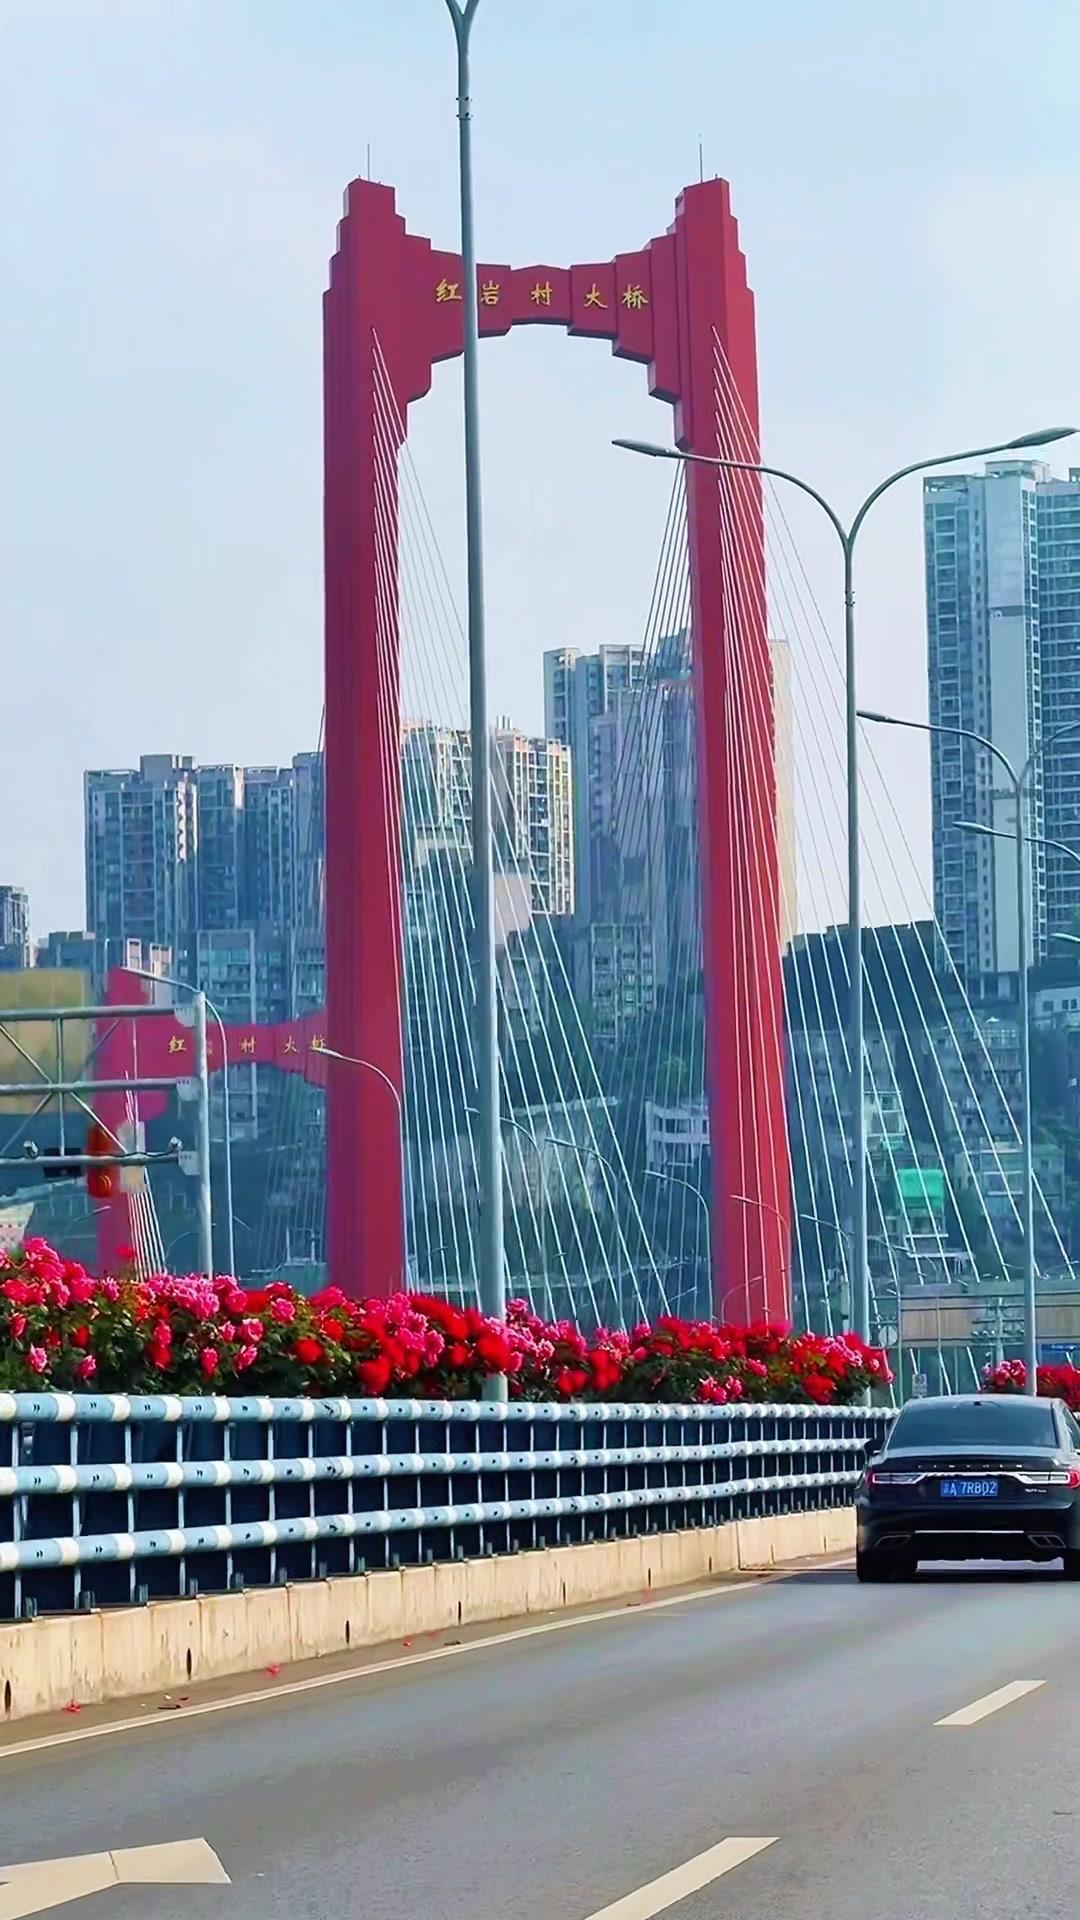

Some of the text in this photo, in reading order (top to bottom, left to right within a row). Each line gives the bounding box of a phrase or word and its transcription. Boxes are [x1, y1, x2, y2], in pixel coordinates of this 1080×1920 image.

[435, 278, 648, 309] 红岩村大桥
